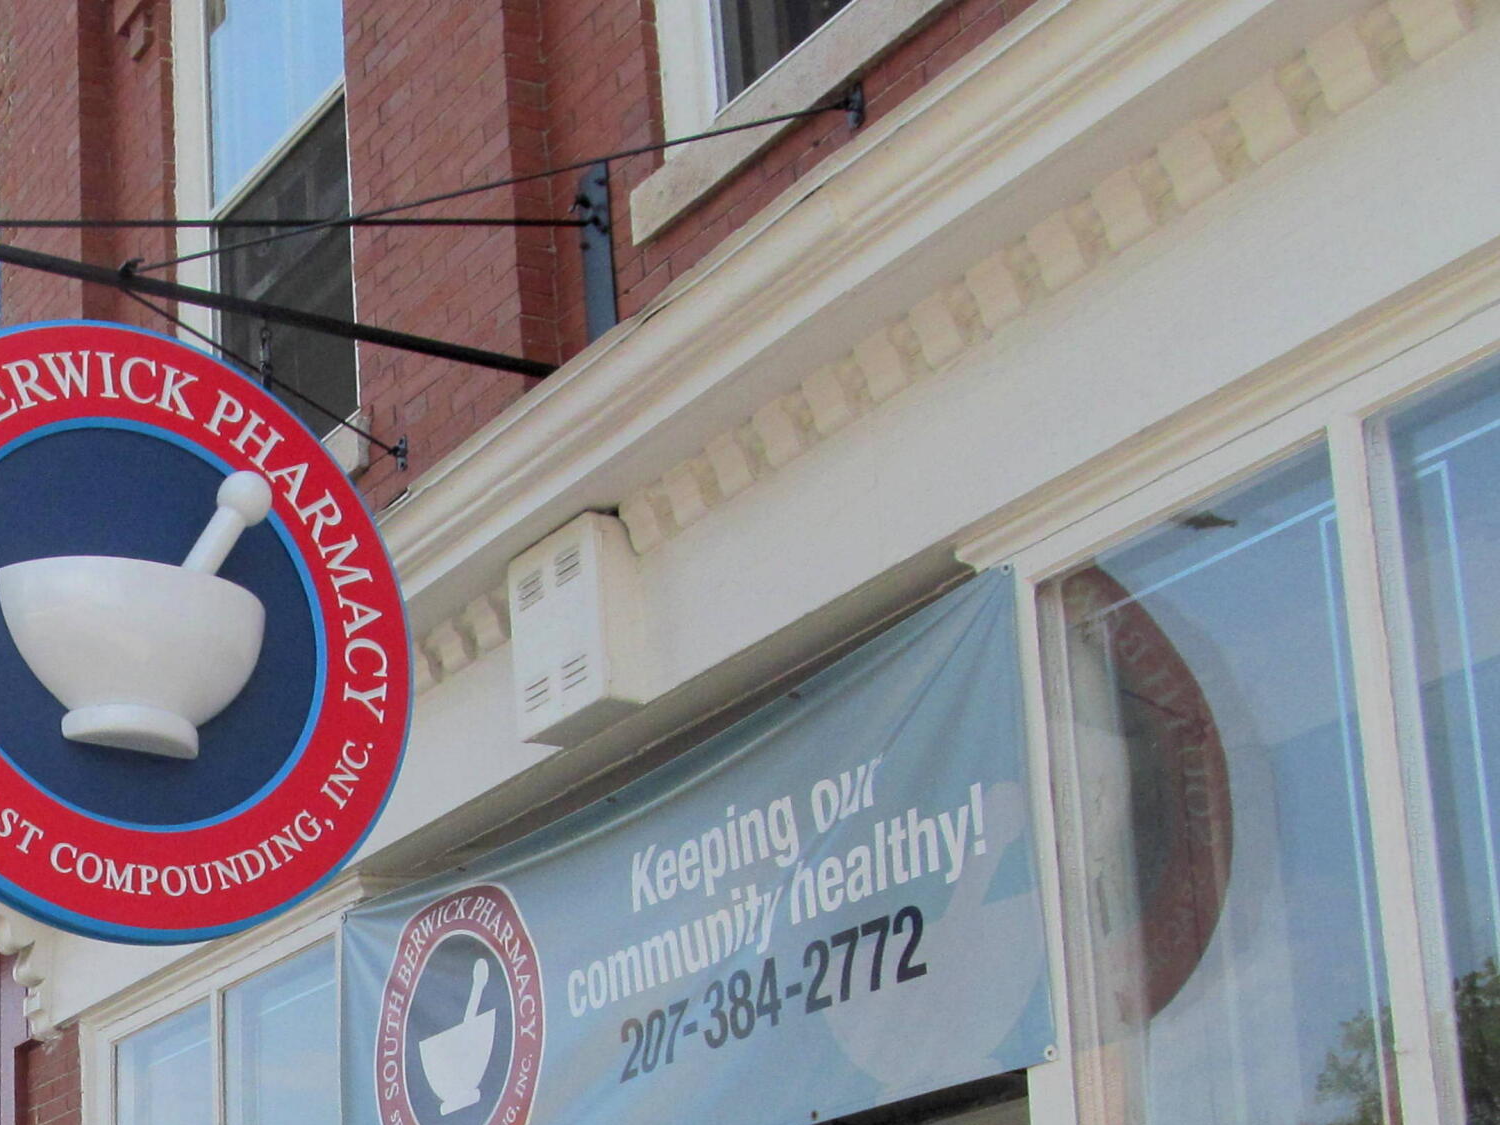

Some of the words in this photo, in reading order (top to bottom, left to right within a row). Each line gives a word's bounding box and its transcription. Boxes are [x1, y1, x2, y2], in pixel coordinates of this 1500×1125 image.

[203, 389, 388, 723] PHARMACY
[49, 809, 334, 896] COMPOUNDING,
[321, 741, 373, 808] INC.
[567, 882, 787, 1018] community
[791, 782, 988, 925] healthy!
[632, 794, 800, 913] Keeping
[812, 753, 882, 833] our
[383, 991, 404, 1100] SOUTH
[398, 896, 473, 988] BERWICK
[472, 896, 536, 1040] PHARMACY
[515, 1054, 533, 1098] INC.
[619, 905, 927, 1084] 207-384-2772
